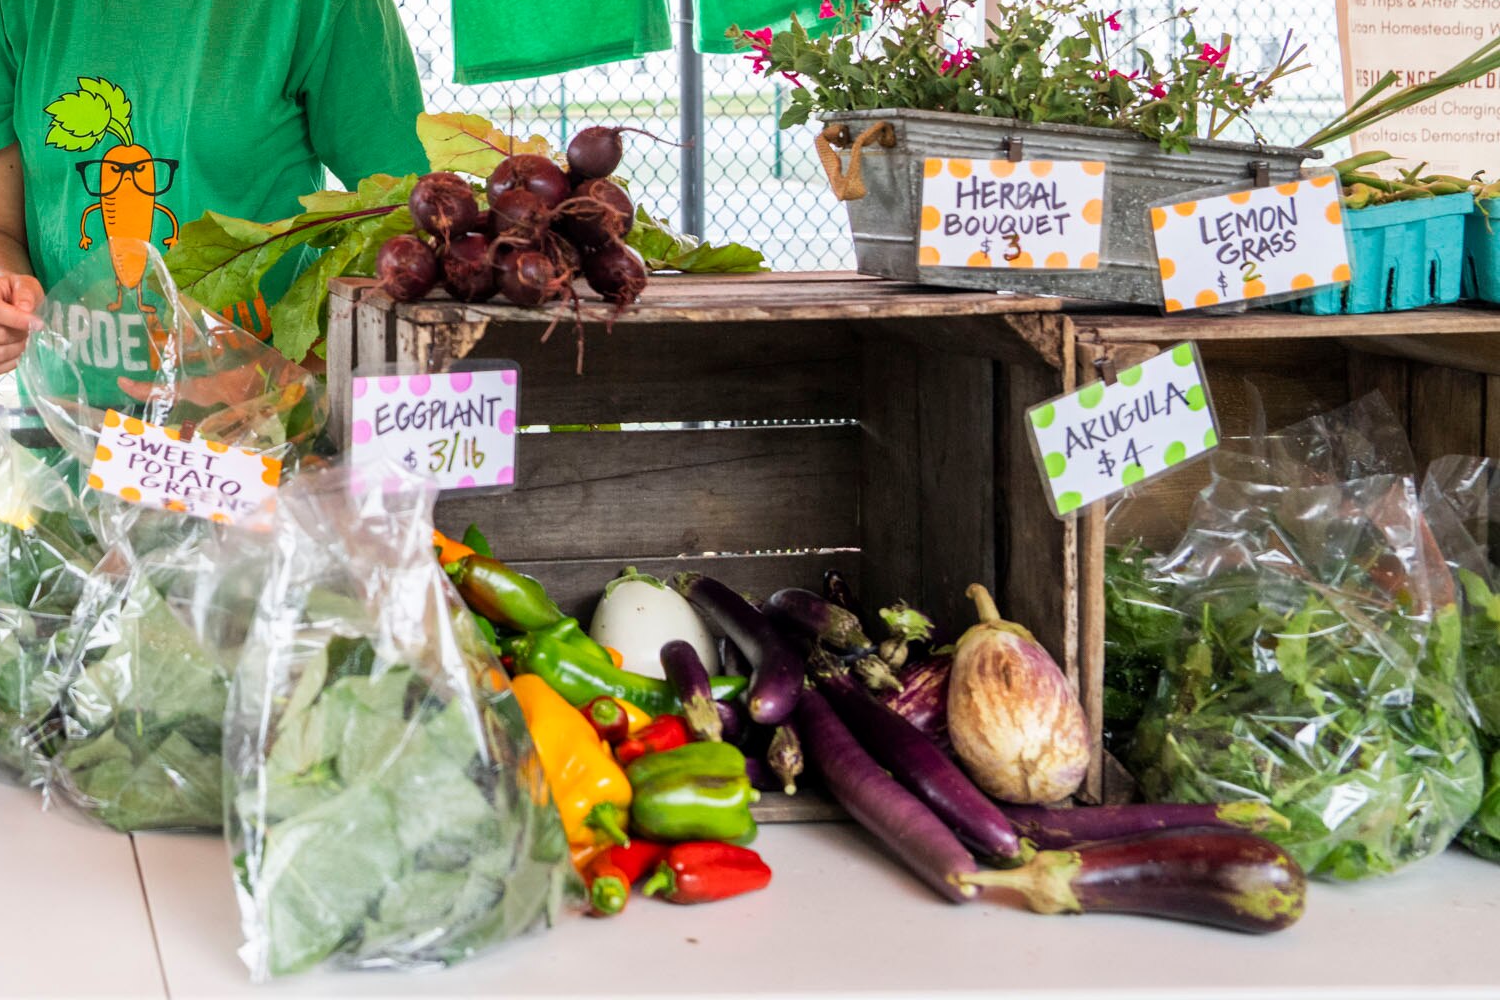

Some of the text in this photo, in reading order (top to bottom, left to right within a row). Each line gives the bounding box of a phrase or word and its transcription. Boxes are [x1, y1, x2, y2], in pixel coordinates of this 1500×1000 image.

[1381, 20, 1485, 40] Homesteading
[955, 175, 1067, 210] HERBAL
[943, 213, 1071, 237] BOUQUET
[1198, 196, 1298, 245] LEMON
[1215, 229, 1297, 265] GRASS
[375, 394, 502, 436] EGGPLANT
[1064, 382, 1190, 459] ARUGULA
[116, 431, 220, 471] SWEET
[128, 453, 242, 496] POTATO
